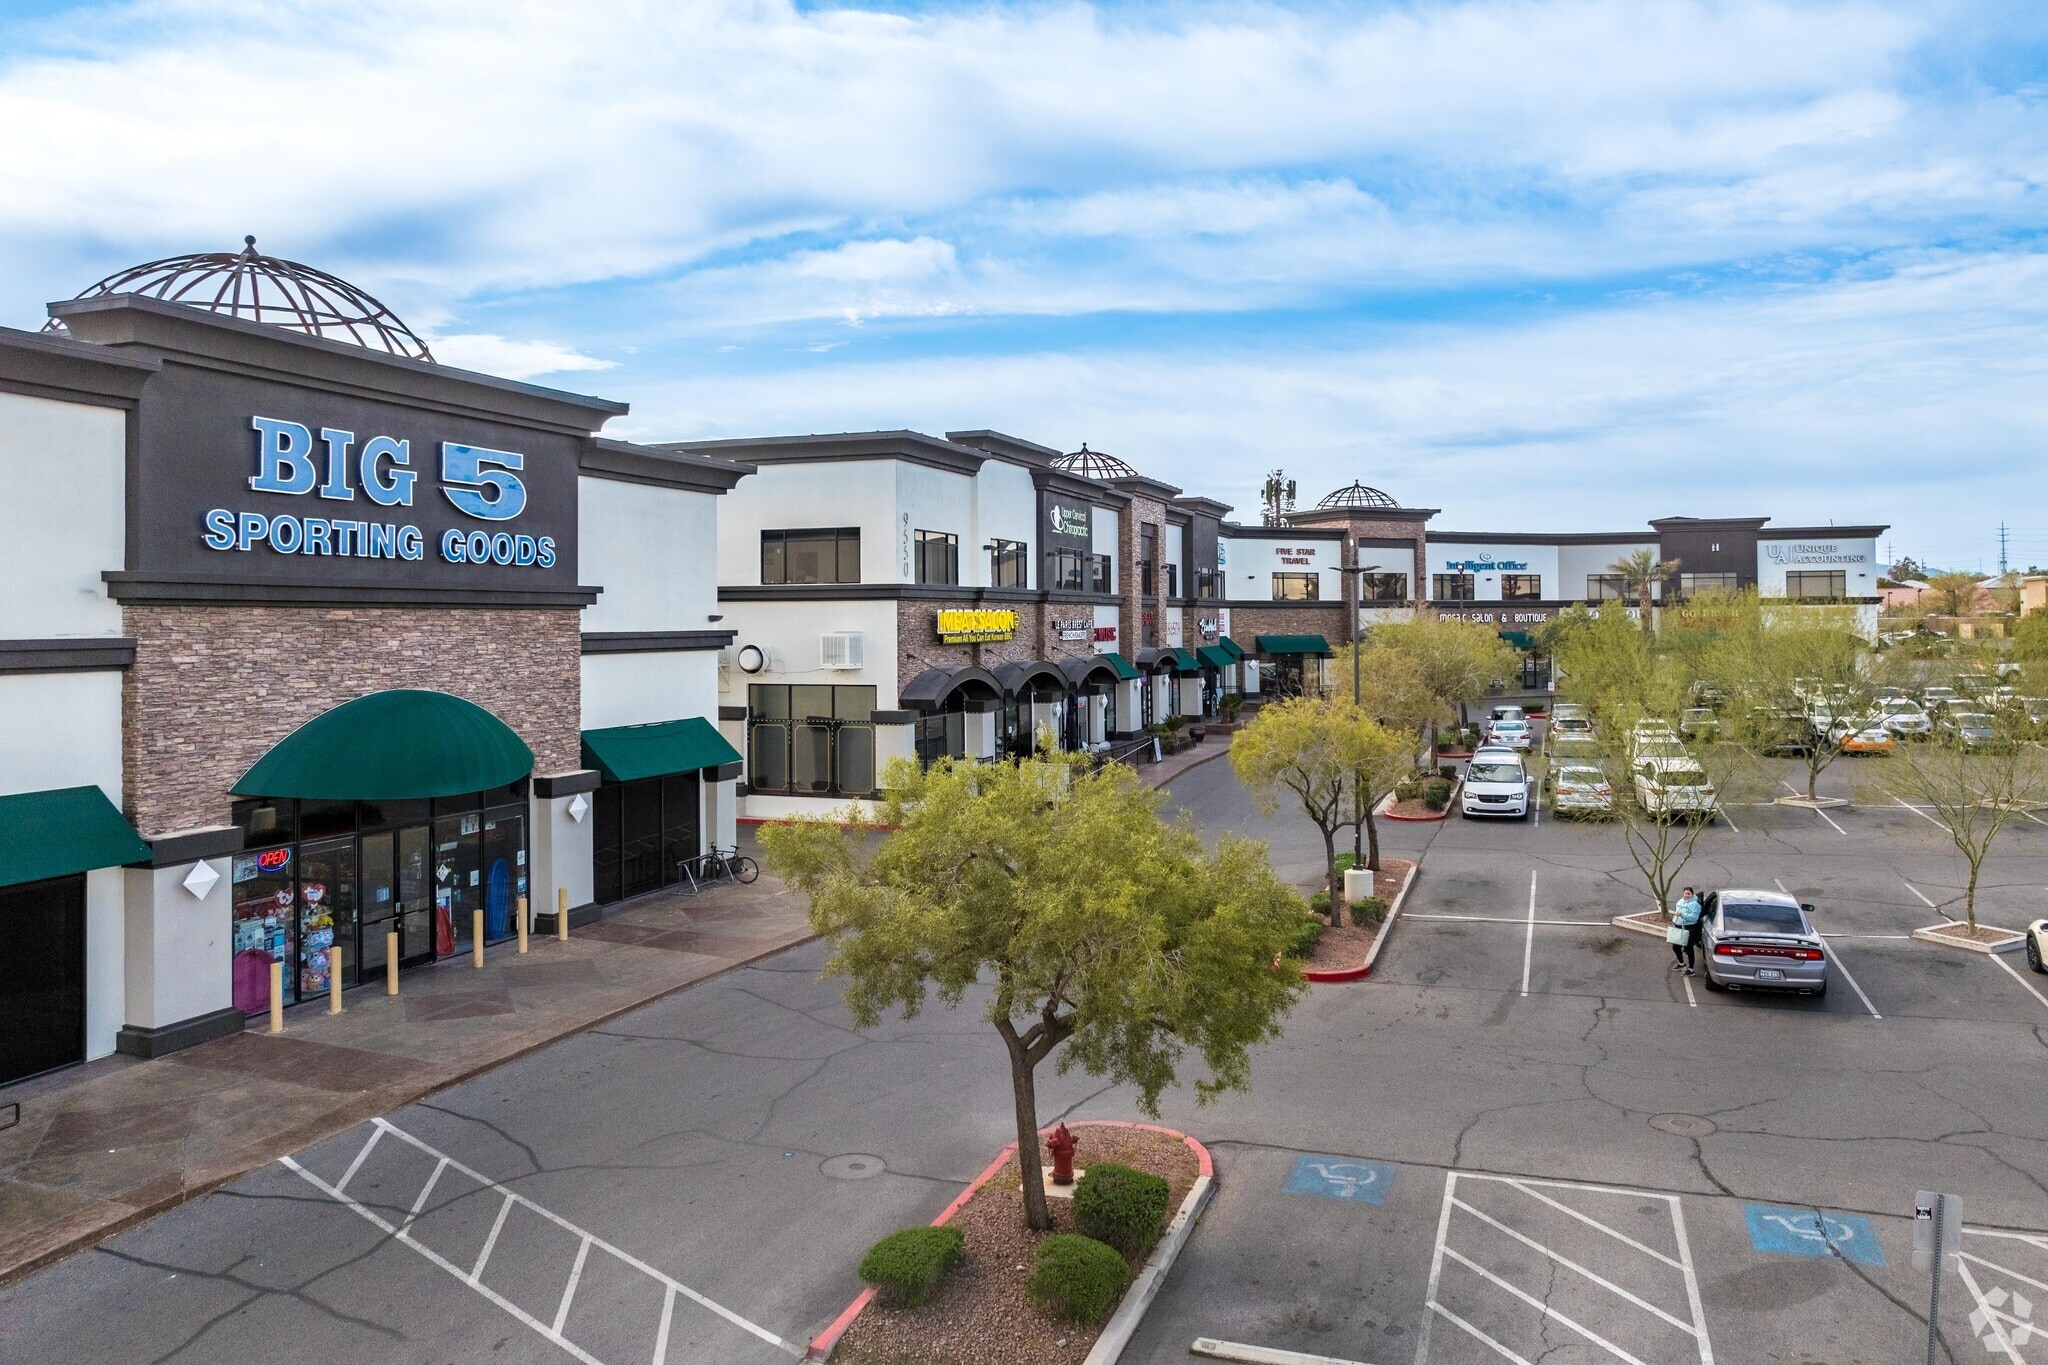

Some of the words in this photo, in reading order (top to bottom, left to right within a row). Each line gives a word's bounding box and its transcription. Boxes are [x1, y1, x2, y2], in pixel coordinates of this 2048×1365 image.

[250, 415, 418, 507] BIG
[440, 441, 527, 521] 5
[1062, 507, 1072, 520] Upper
[1072, 510, 1087, 522] Cervical
[1063, 520, 1089, 538] Chiropractic
[203, 508, 424, 561] SPORTING
[441, 528, 557, 568] GOODS
[1275, 547, 1293, 556] FIVE
[1296, 548, 1316, 556] STAR
[1794, 544, 1837, 554] UNIQUE
[1281, 557, 1311, 565] TRAVEL
[1794, 555, 1866, 564] ACCOUNTING
[1446, 560, 1496, 573] Intlligent
[1497, 560, 1526, 571] Office
[1501, 613, 1508, 623] &
[1514, 613, 1547, 623] BOUTIQUE
[944, 634, 962, 643] Premium
[991, 633, 1004, 641] Korean
[1004, 632, 1013, 640] BBQ
[259, 850, 288, 867] OPEN
